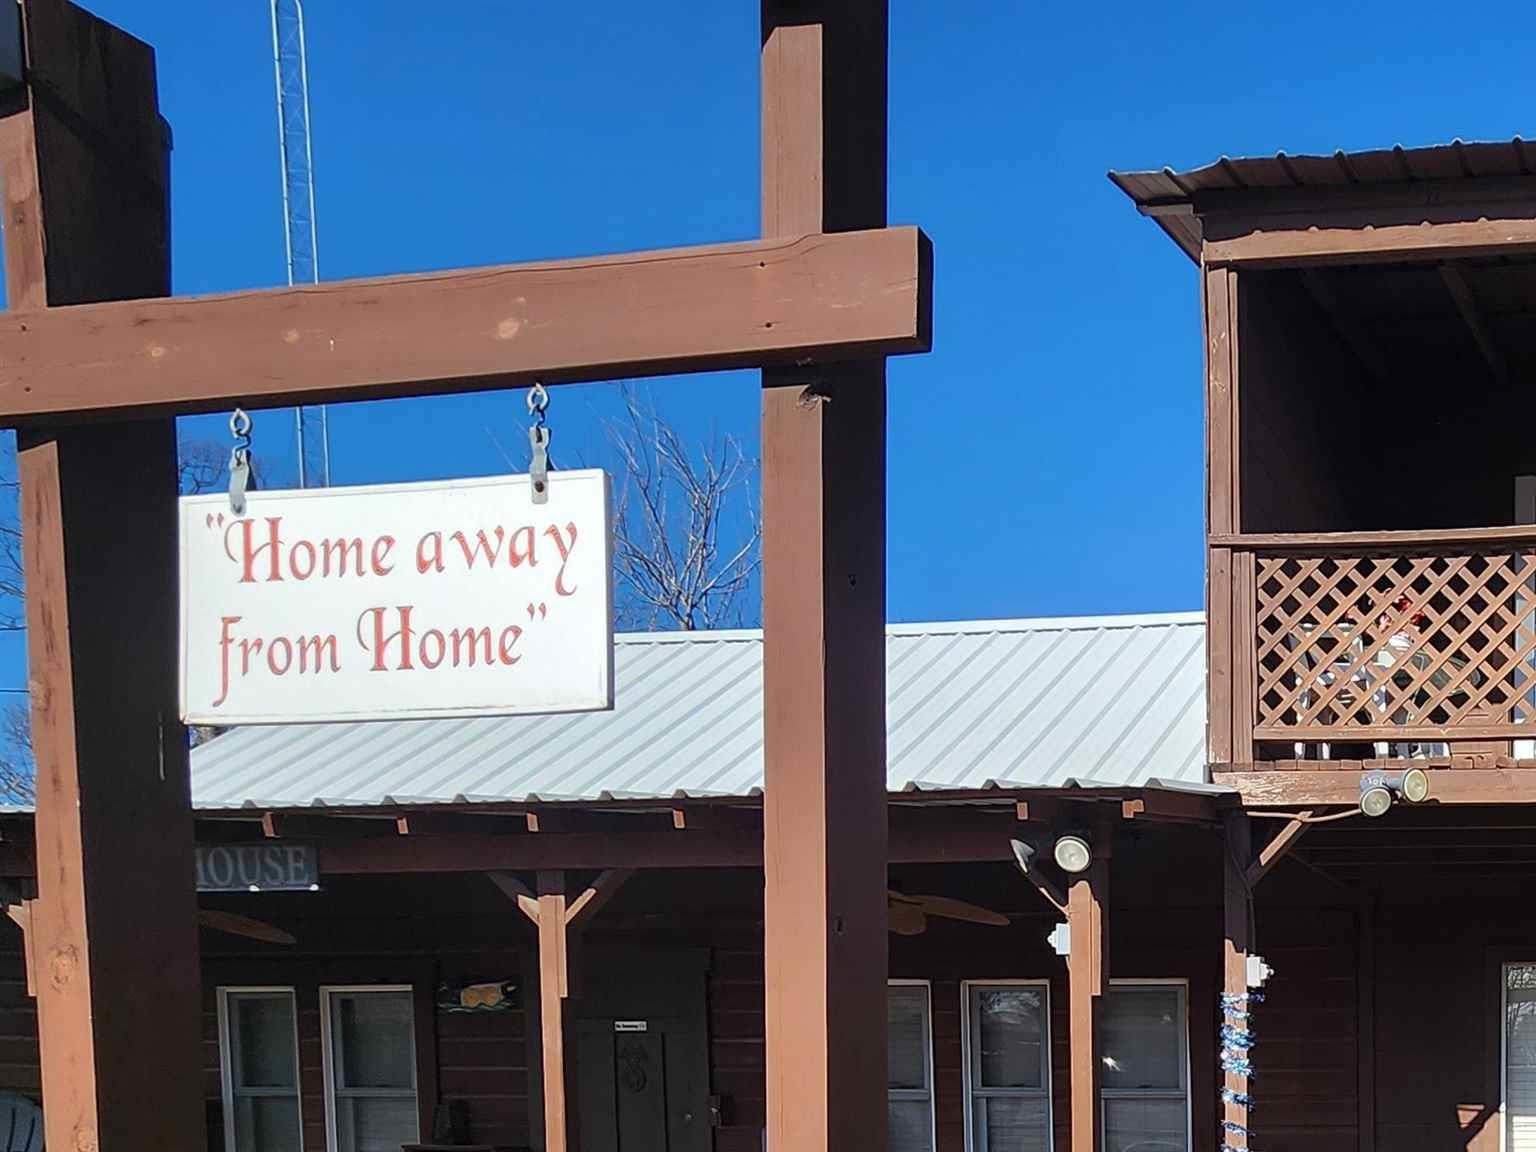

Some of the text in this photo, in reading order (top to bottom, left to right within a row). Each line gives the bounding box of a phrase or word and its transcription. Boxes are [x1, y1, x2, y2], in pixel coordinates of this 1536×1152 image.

[206, 512, 579, 597] "Home away
[357, 602, 547, 673] Home"
